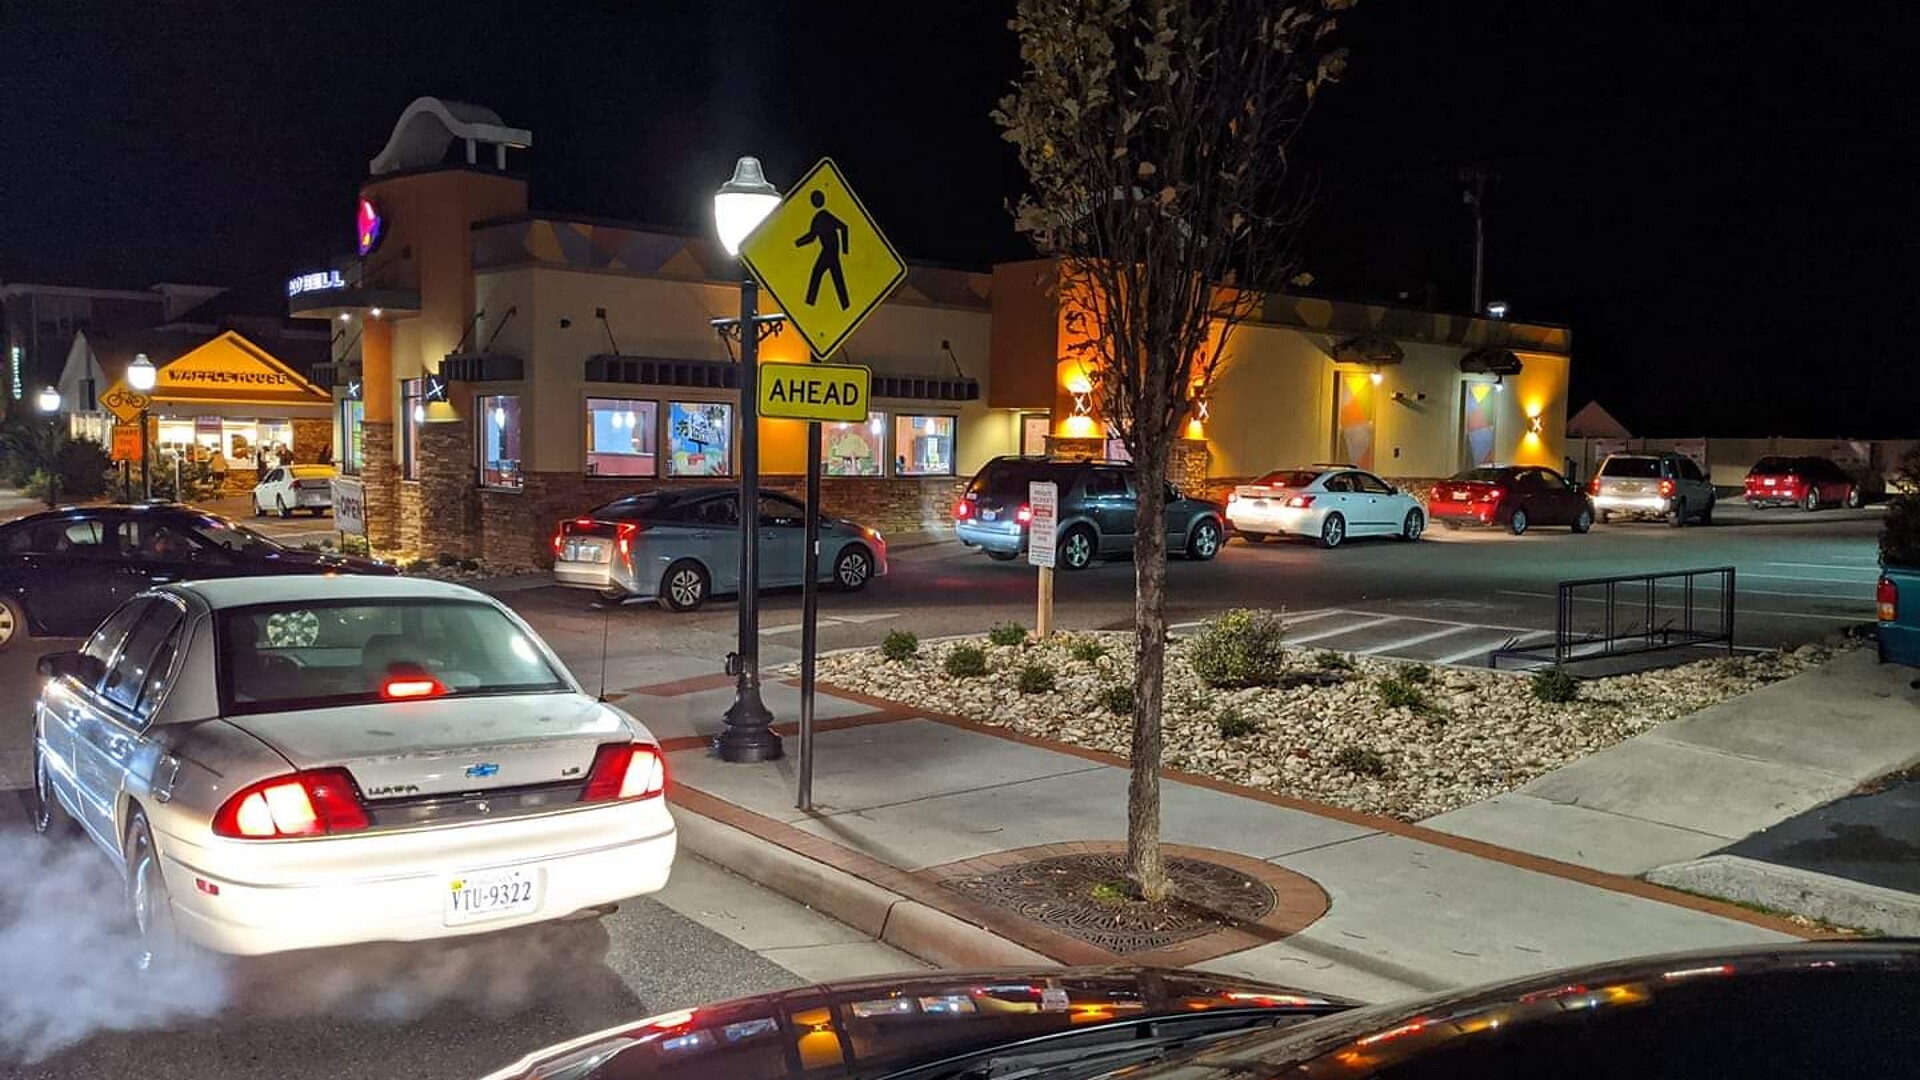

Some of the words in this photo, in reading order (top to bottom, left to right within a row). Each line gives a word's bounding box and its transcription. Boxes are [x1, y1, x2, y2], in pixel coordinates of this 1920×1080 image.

[303, 270, 345, 291] BELL
[168, 368, 231, 382] WAFFLE
[233, 369, 288, 385] HOUSE
[769, 378, 859, 406] AHEAD
[451, 881, 532, 911] VTU-9322
